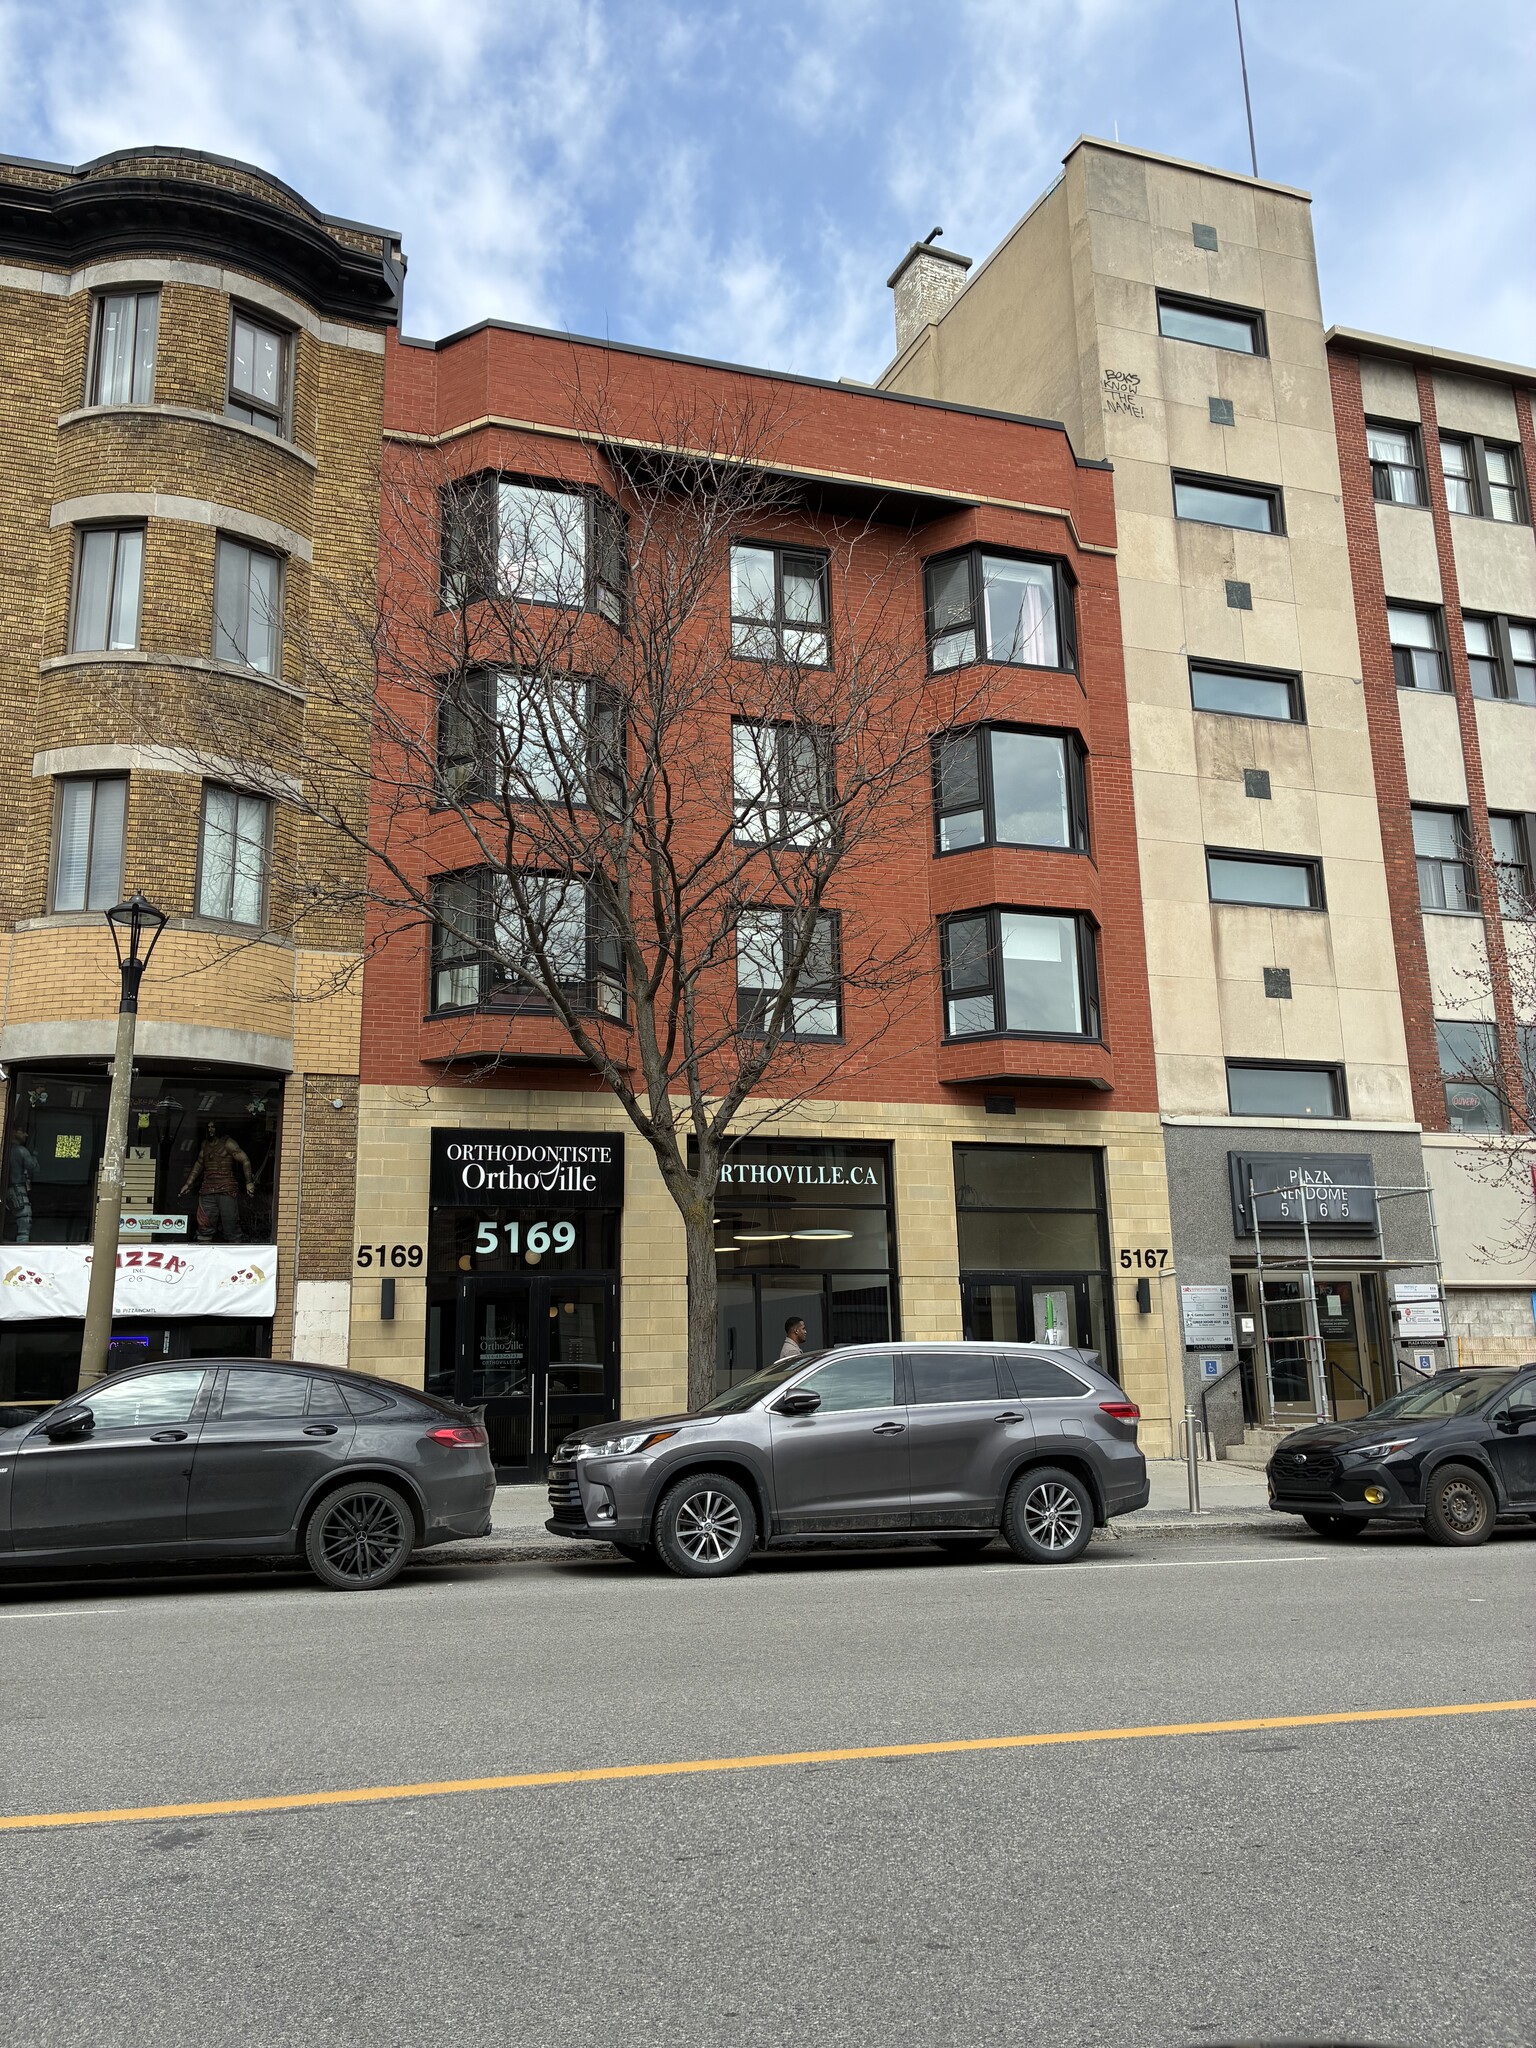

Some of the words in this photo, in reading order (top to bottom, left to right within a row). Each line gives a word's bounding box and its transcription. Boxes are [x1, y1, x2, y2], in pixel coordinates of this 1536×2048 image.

[1104, 380, 1137, 394] KNOW
[1105, 390, 1136, 406] THE
[1107, 399, 1145, 419] NAME!
[446, 1143, 612, 1164] ORTHODONTISTE
[719, 1164, 878, 1185] RTHOVILLE.CA
[1289, 1169, 1333, 1184] PAZA
[1281, 1202, 1350, 1217] 565
[475, 1221, 576, 1254] 5169
[86, 1251, 187, 1274] IZZA
[356, 1244, 424, 1268] 5169
[1120, 1249, 1169, 1269] 5167
